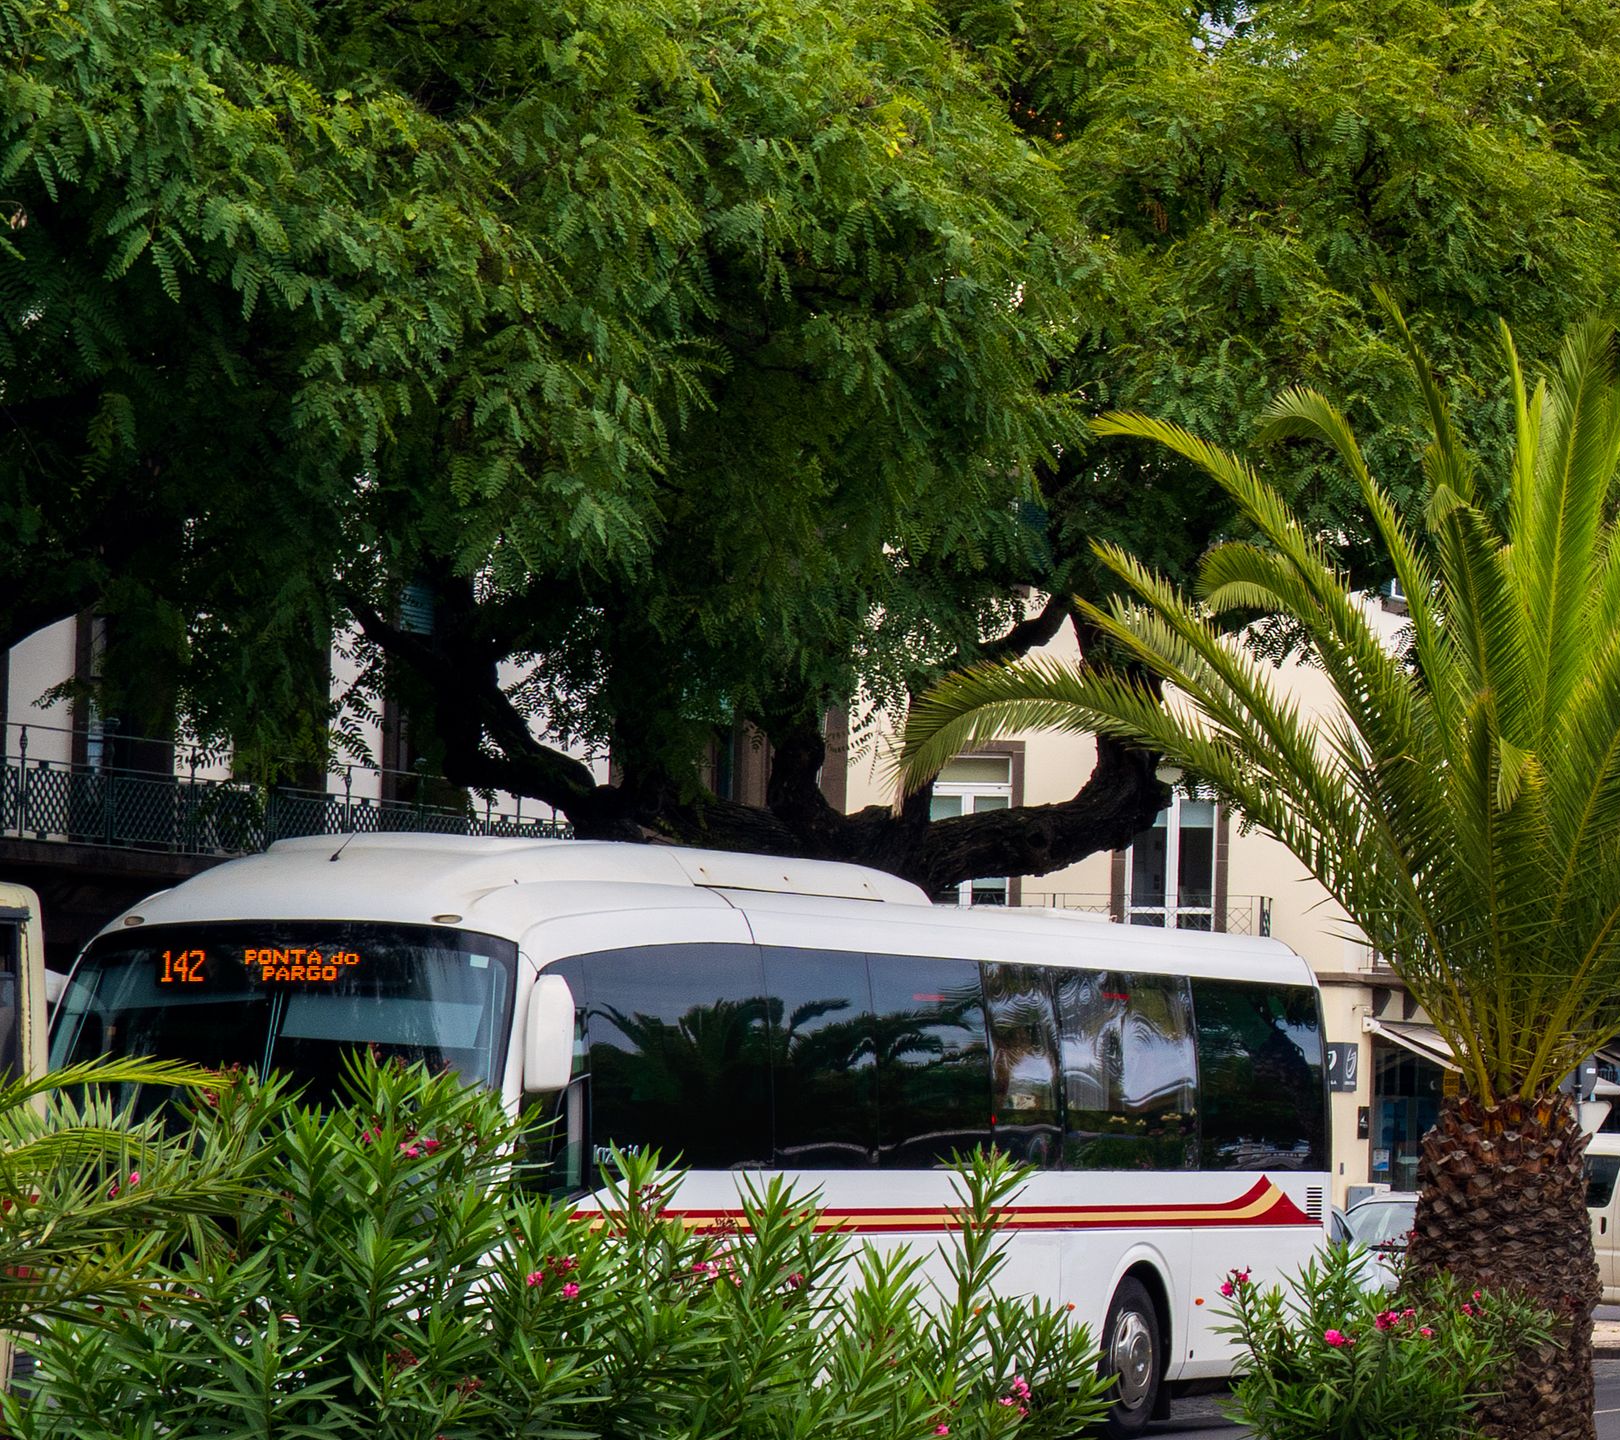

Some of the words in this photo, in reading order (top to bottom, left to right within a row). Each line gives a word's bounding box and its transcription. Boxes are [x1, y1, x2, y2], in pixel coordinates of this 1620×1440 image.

[244, 949, 322, 965] PONTA
[330, 951, 360, 965] do
[161, 950, 205, 982] 142
[262, 965, 338, 981] PARGO
